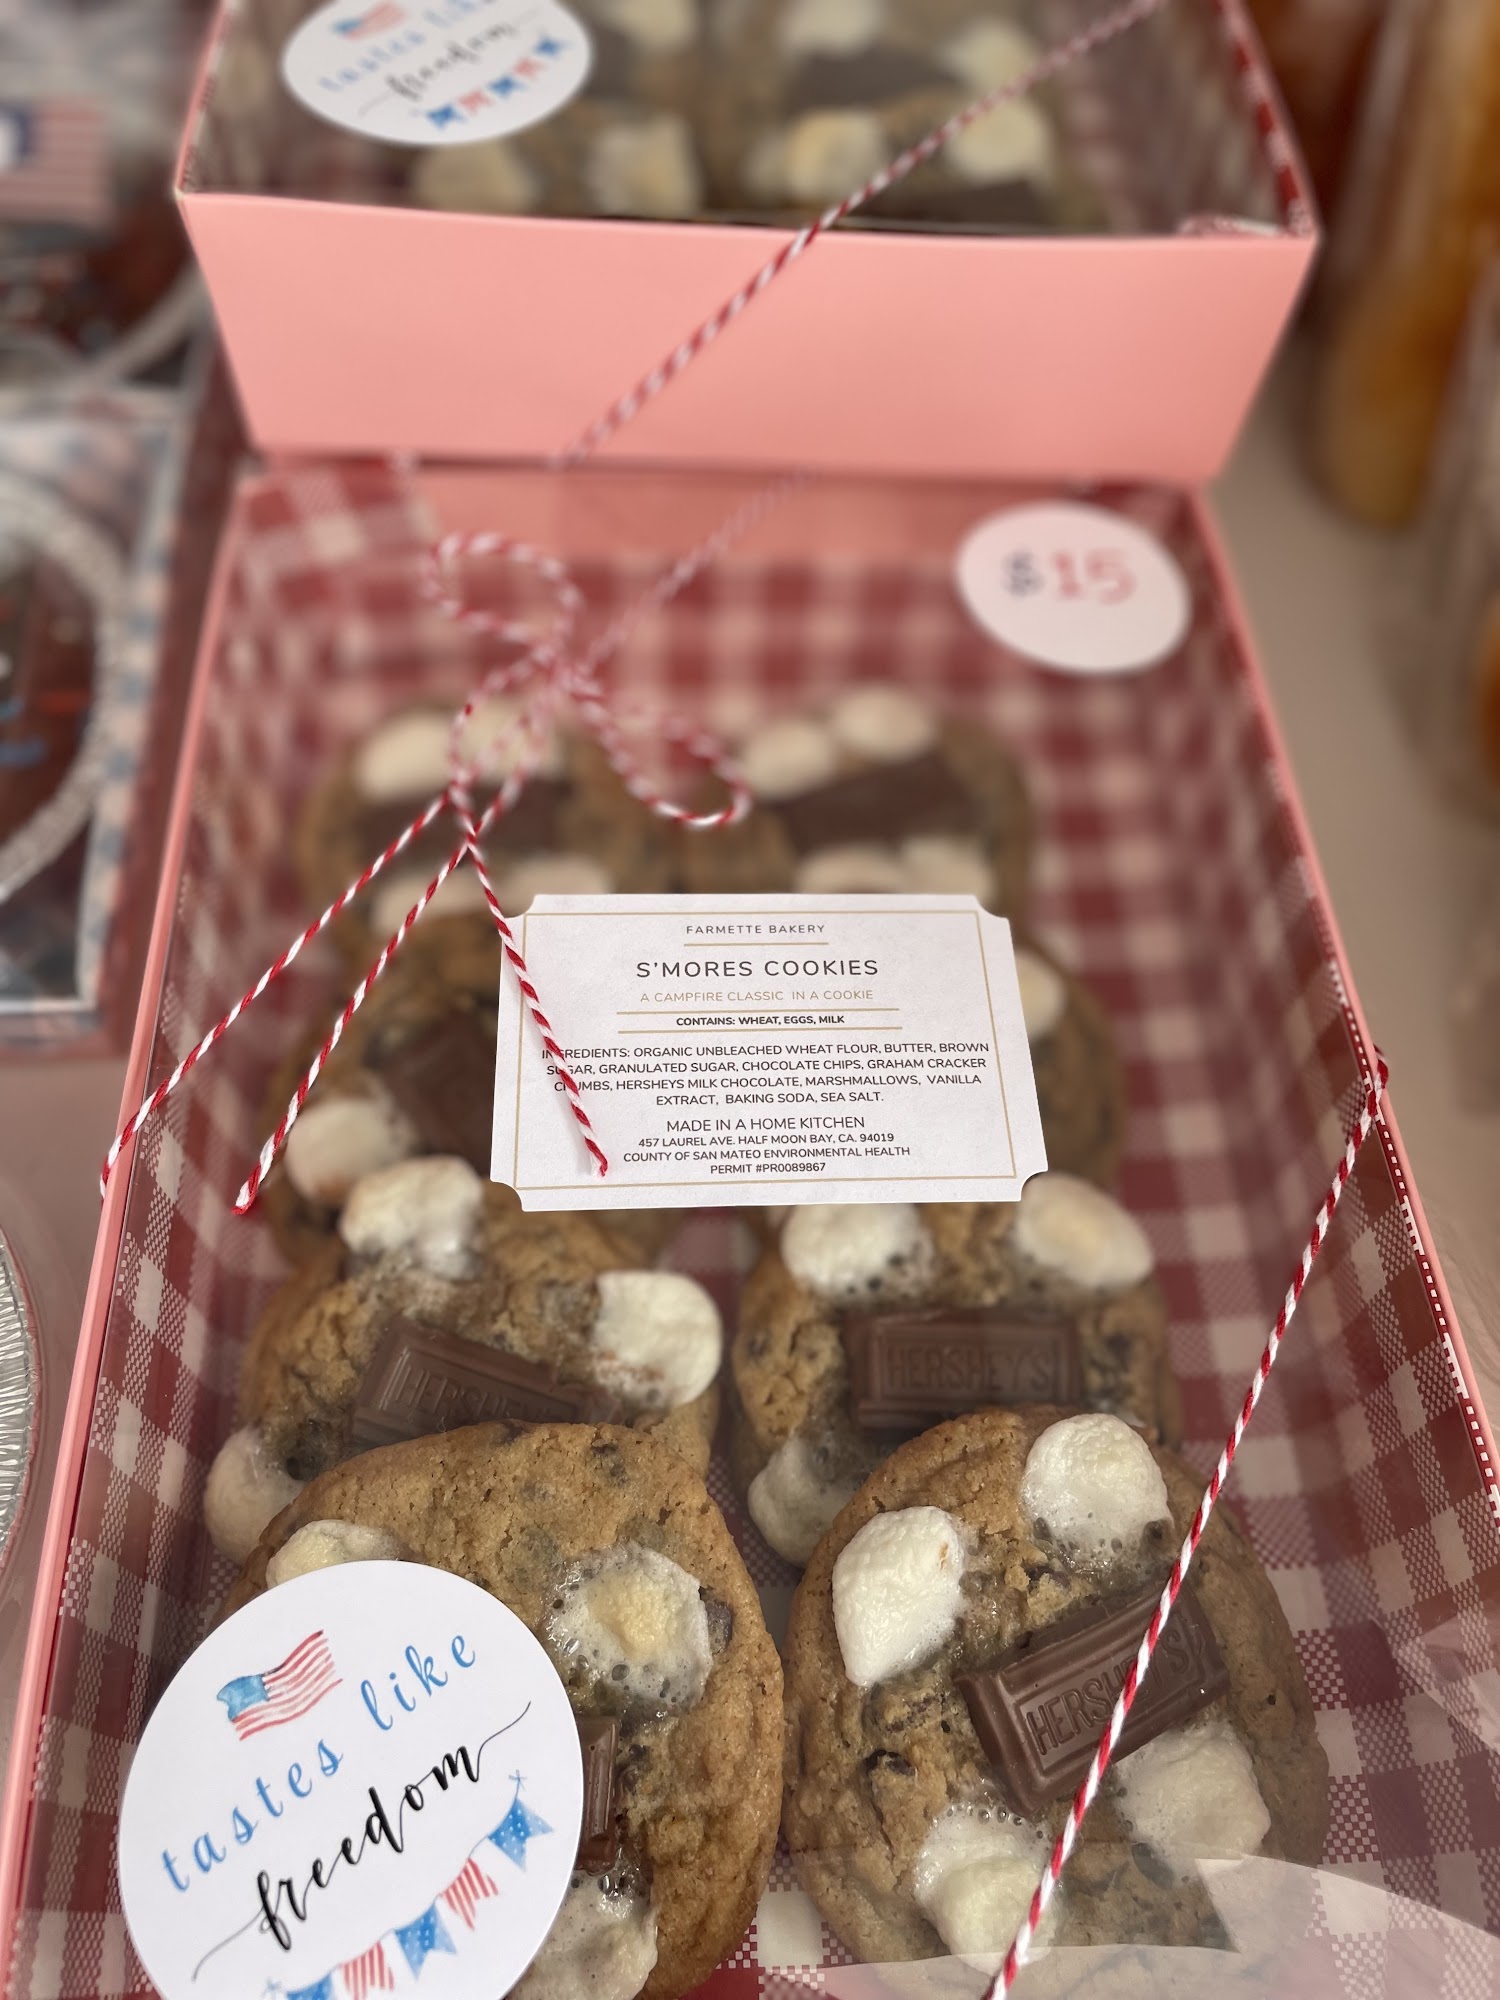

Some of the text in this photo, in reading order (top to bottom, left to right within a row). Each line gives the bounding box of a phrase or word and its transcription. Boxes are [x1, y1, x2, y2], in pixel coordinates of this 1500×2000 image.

[1003, 549, 1137, 605] $15
[686, 924, 825, 935] FARMETTE BAKERY
[636, 959, 879, 978] S'MORES COOKIES
[641, 989, 874, 1003] A CAMPFIRE CLASSIC IN A COOKIE
[676, 1015, 844, 1026] CONTAINS: WHEAT, EGGS, MILK
[542, 1041, 989, 1060] INREDIENTS: ORGANIC UNBLEACHED WHEAT FLOUR, BUTTER, BROWN
[599, 1061, 687, 1074] GRANULATED
[691, 1060, 739, 1073] SUGAR,
[742, 1059, 820, 1072] CHOCOLATE
[823, 1059, 864, 1072] CHIPS,
[867, 1058, 925, 1070] GRAHAM
[928, 1057, 986, 1069] CRACKER
[616, 1078, 684, 1091] HERSHEYS
[688, 1077, 717, 1089] MILK
[720, 1076, 803, 1090] CHOCOLATE,
[806, 1074, 921, 1088] MARSHMALLOWS,
[927, 1073, 981, 1086] VANILLA
[656, 1090, 884, 1107] EXTRACT, BAKING SODA, SEA SALT.
[667, 1116, 865, 1132] MADE IN A HOME KITCHEN
[639, 1132, 895, 1147] 457 LAUREL AVE. HALF MOON BAY, CA. 94019
[624, 1146, 910, 1162] COUNTY OF SAN MATEO ENVIRONMENTAL HEALTH
[710, 1162, 826, 1175] PERMIT #PR0089867
[162, 1634, 476, 1892] tastes like
[191, 1701, 532, 1982] freedom
